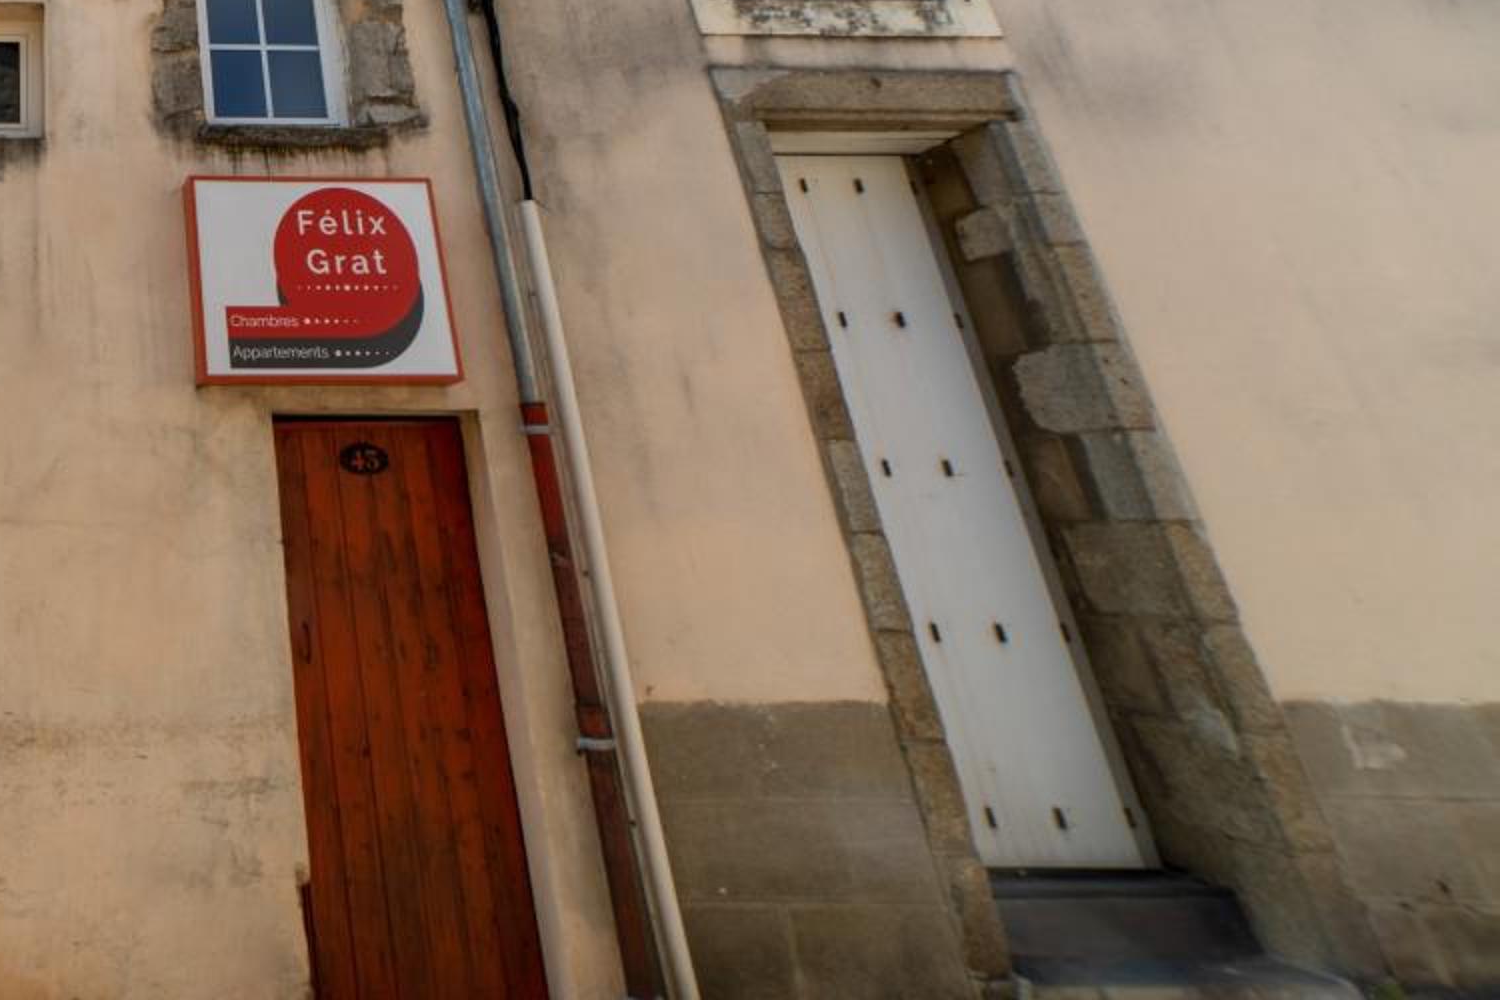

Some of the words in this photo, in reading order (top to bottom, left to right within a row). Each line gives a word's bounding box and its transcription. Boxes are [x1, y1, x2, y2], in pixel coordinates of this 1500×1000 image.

[296, 209, 387, 235] Félix
[306, 248, 388, 275] Grat
[229, 313, 300, 328] Chambres
[232, 345, 330, 361] Appartements
